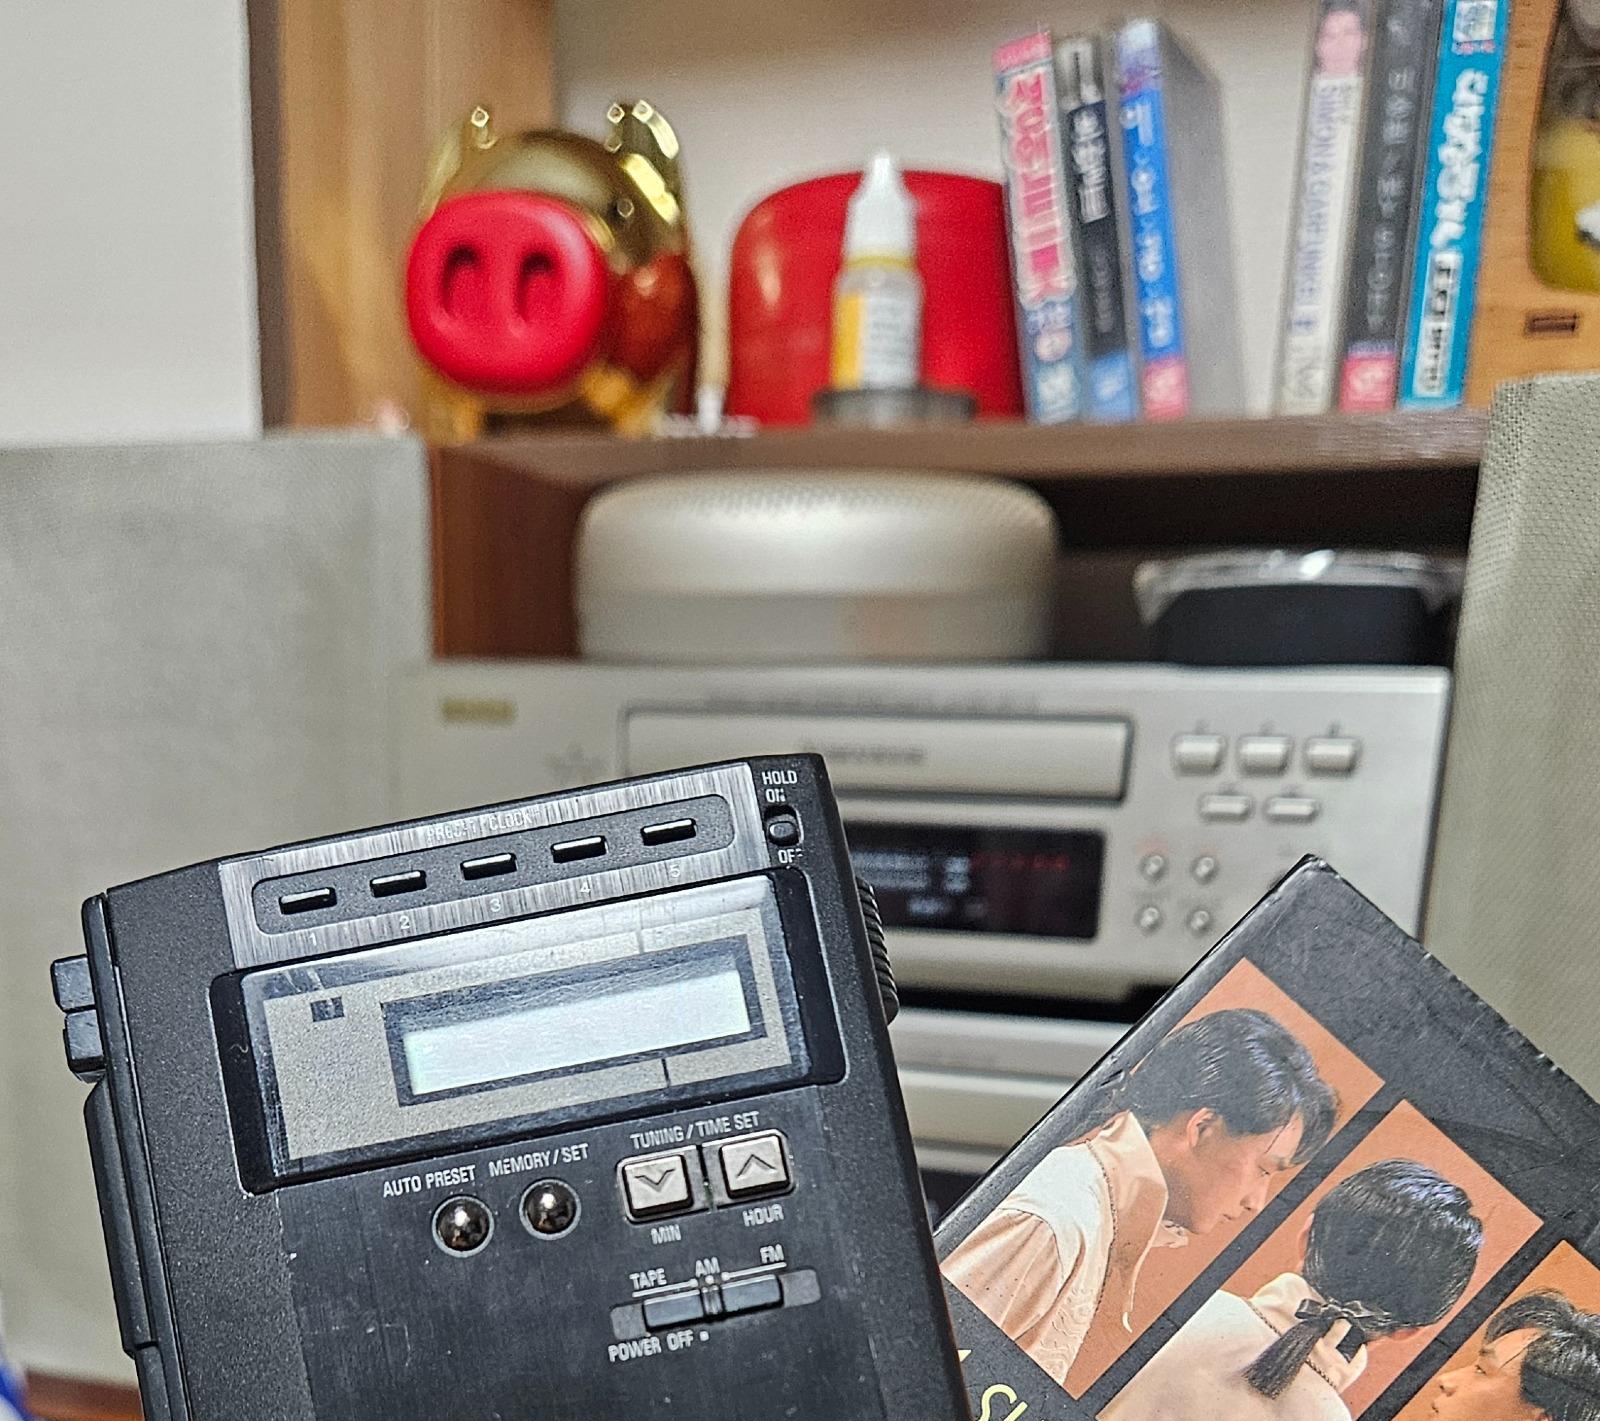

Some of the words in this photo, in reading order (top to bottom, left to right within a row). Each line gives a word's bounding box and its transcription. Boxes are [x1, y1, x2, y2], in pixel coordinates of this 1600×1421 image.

[762, 770, 798, 785] HOLD
[765, 788, 786, 803] ON
[400, 915, 410, 930] 2
[490, 899, 502, 914] 3
[580, 882, 591, 896] 4
[670, 863, 681, 879] 5
[733, 1110, 760, 1130] SET
[383, 1176, 422, 1198] AUTO
[425, 1164, 476, 1189] PRESET
[743, 1204, 784, 1227] HOUR
[651, 1225, 682, 1244] MIN
[760, 1245, 785, 1264] FM
[695, 1260, 720, 1278] AM
[630, 1269, 667, 1290] TAPE
[608, 1338, 662, 1363] POWER
[666, 1330, 695, 1351] OFF
